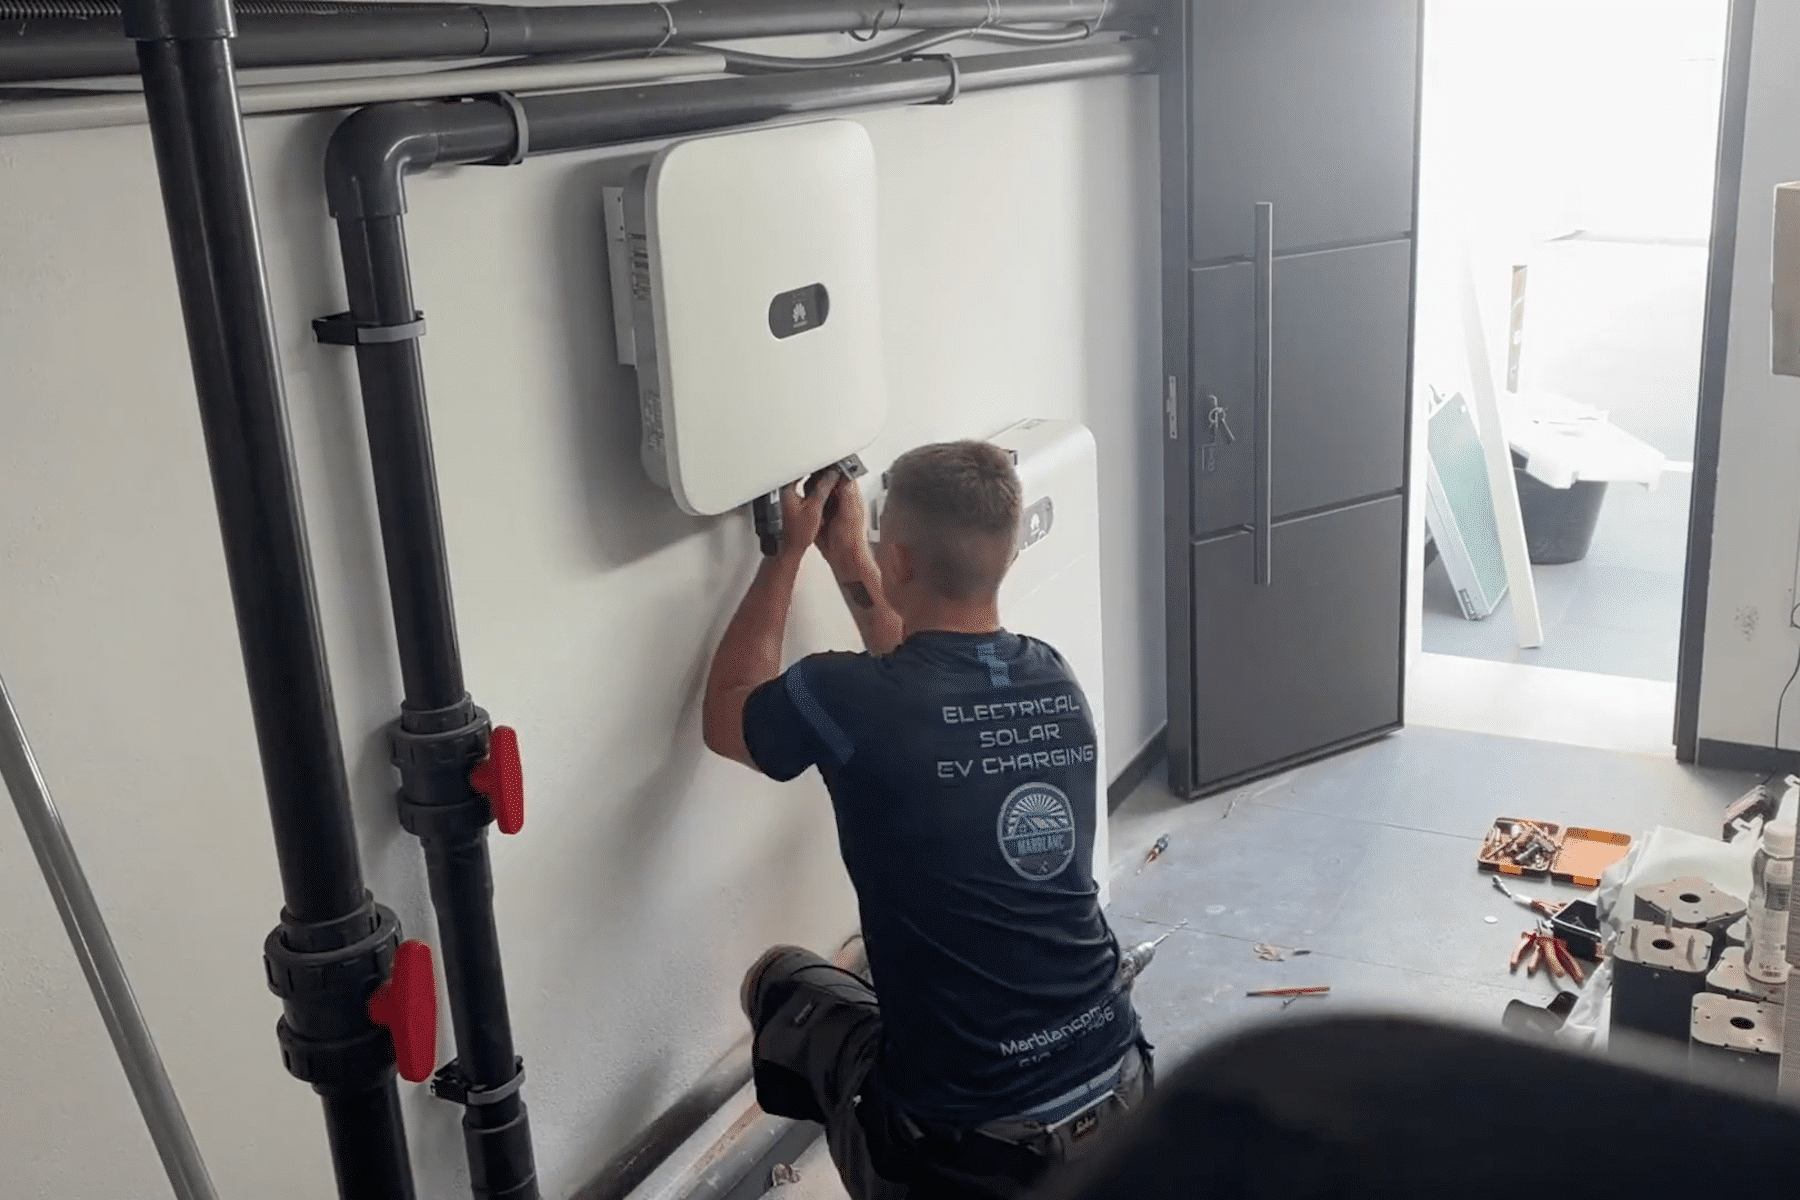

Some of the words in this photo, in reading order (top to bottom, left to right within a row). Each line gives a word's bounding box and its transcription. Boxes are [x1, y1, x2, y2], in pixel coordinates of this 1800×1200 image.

[942, 695, 1080, 724] ELECTRICAL
[979, 723, 1062, 748] SOLAR
[937, 760, 973, 778] EV
[982, 744, 1094, 775] CHARGING
